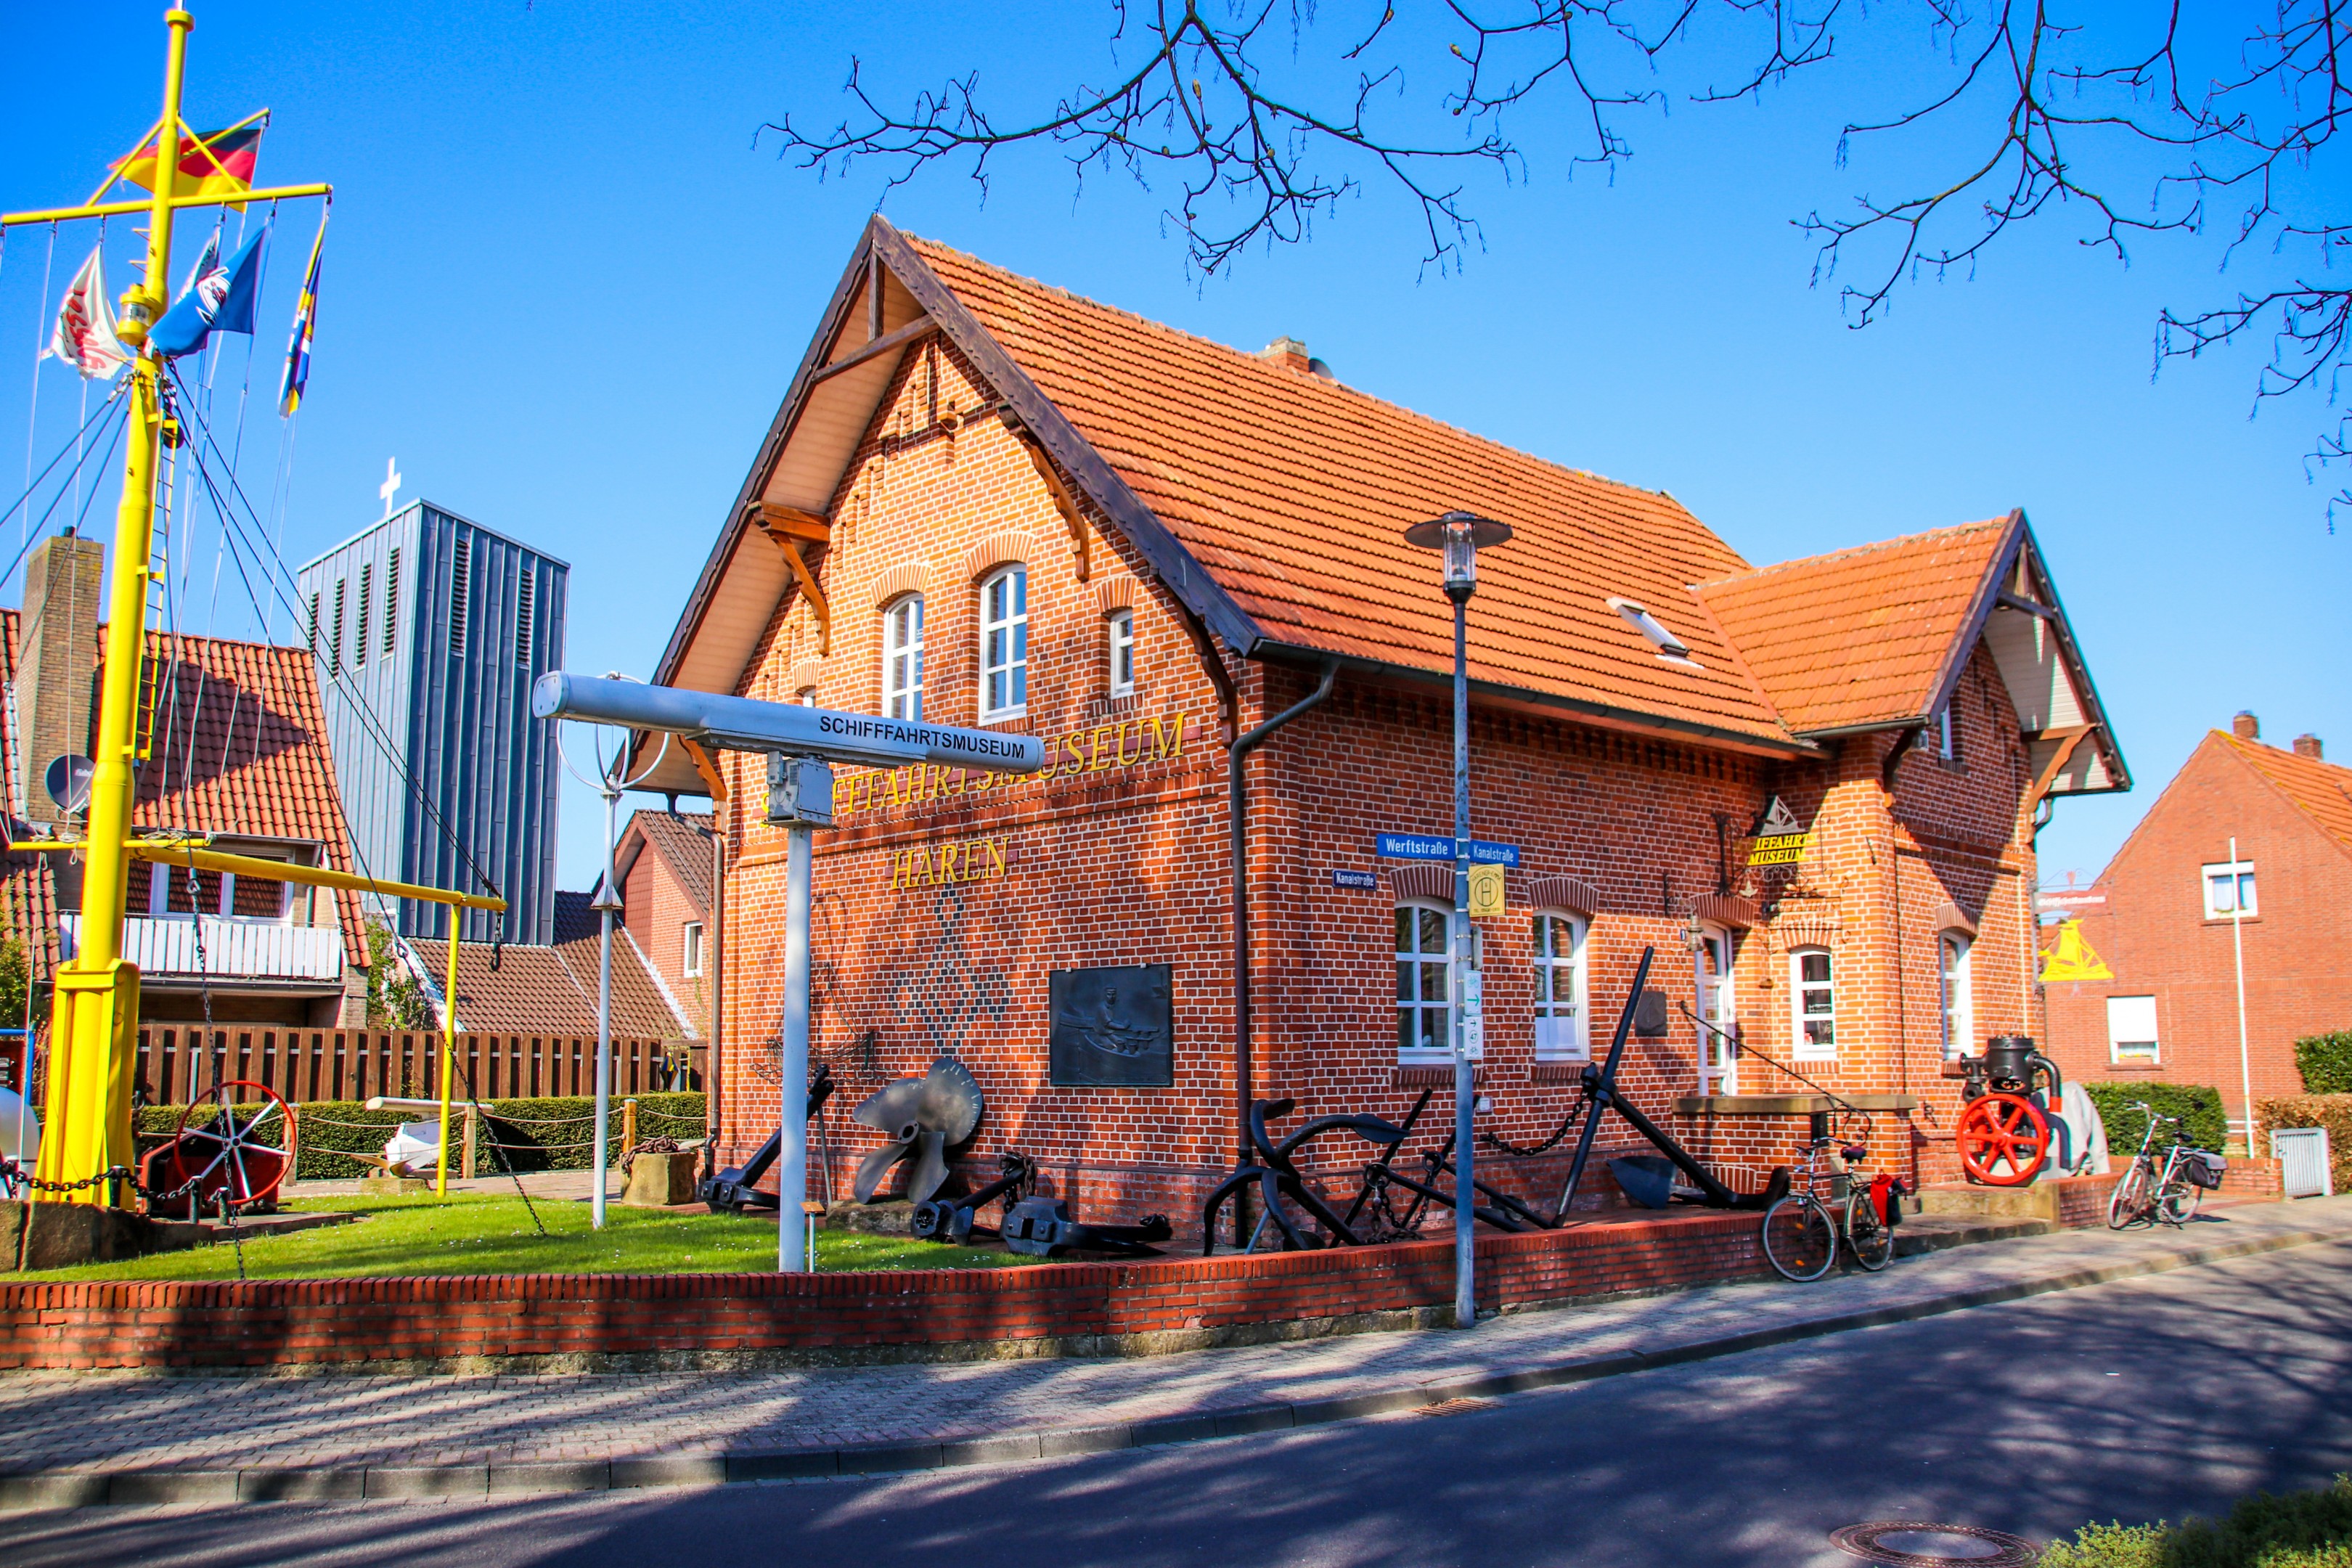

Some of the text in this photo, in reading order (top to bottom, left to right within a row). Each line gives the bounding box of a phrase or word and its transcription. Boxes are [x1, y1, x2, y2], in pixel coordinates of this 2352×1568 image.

[820, 715, 1025, 759] SCHIFFFAHRTSMUSEUM
[1386, 838, 1448, 855] Werftstraße
[1473, 844, 1514, 862] Kanalstraße
[891, 836, 1010, 890] HAREN
[1747, 847, 1808, 866] MUSEUM
[1336, 872, 1374, 887] Kanalstraße
